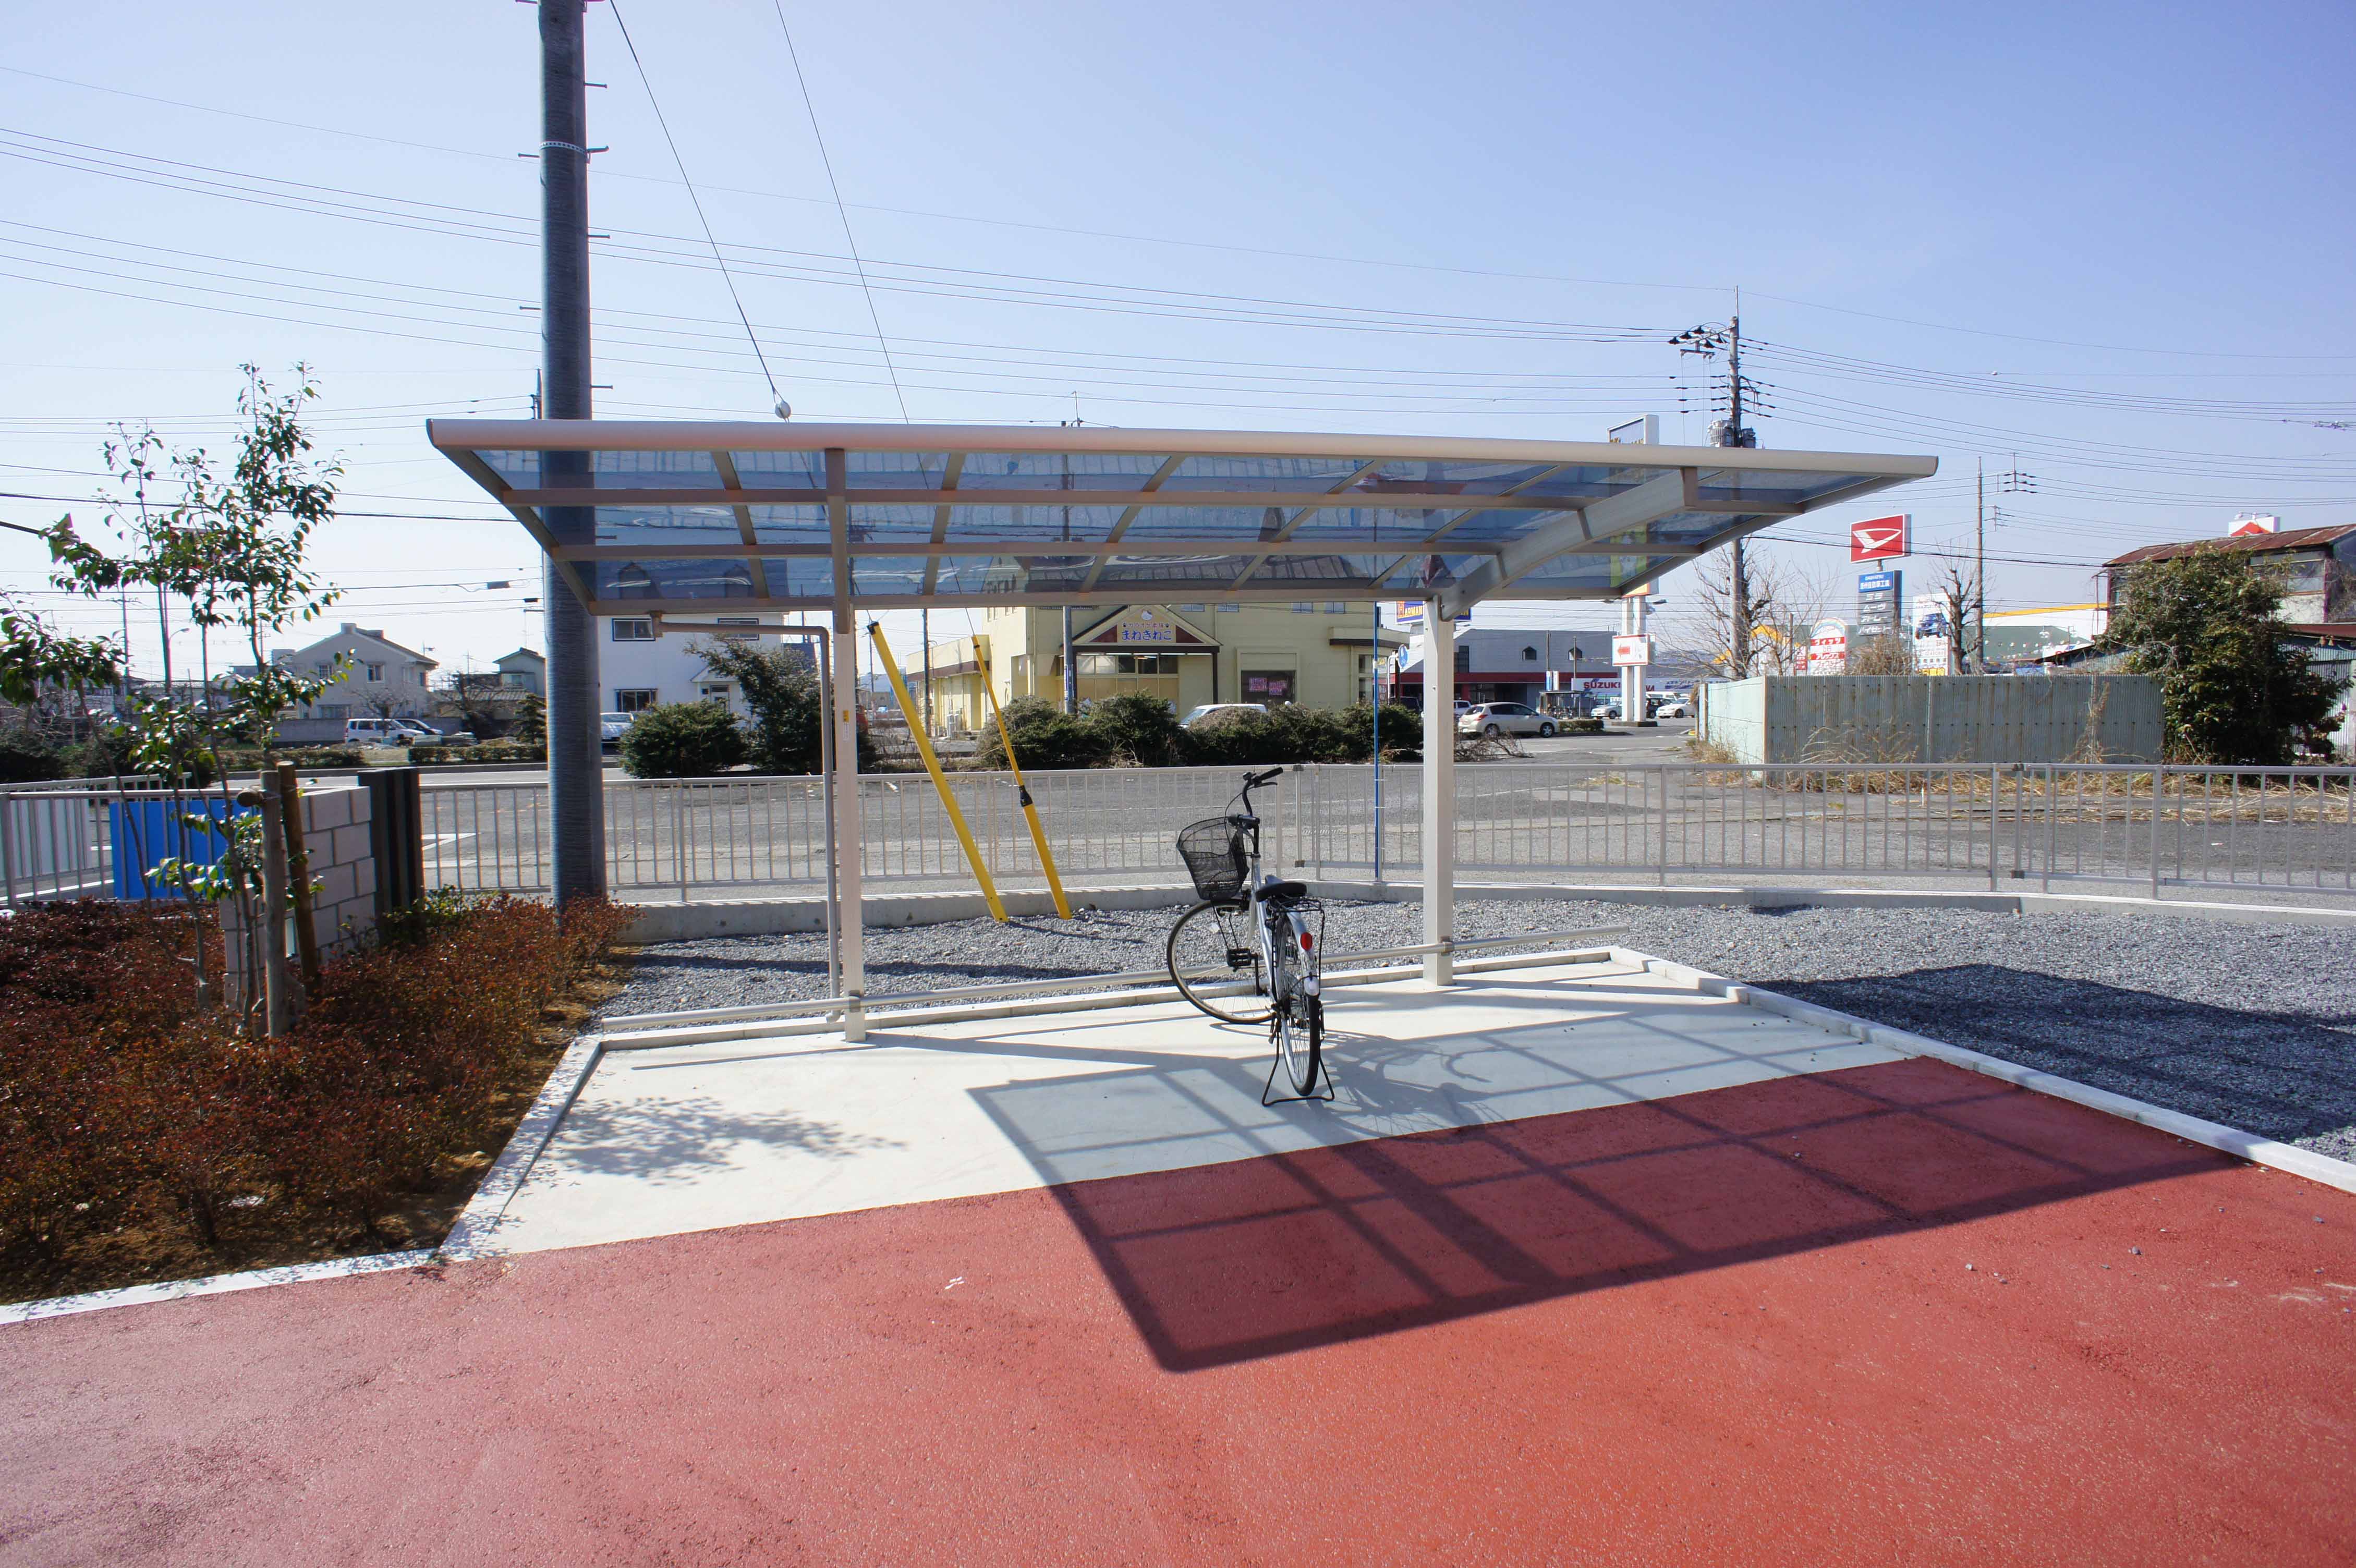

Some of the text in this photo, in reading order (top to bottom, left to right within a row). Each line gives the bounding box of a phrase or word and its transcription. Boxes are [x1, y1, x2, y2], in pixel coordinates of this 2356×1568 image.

[1122, 629, 1172, 641] まねきねこ
